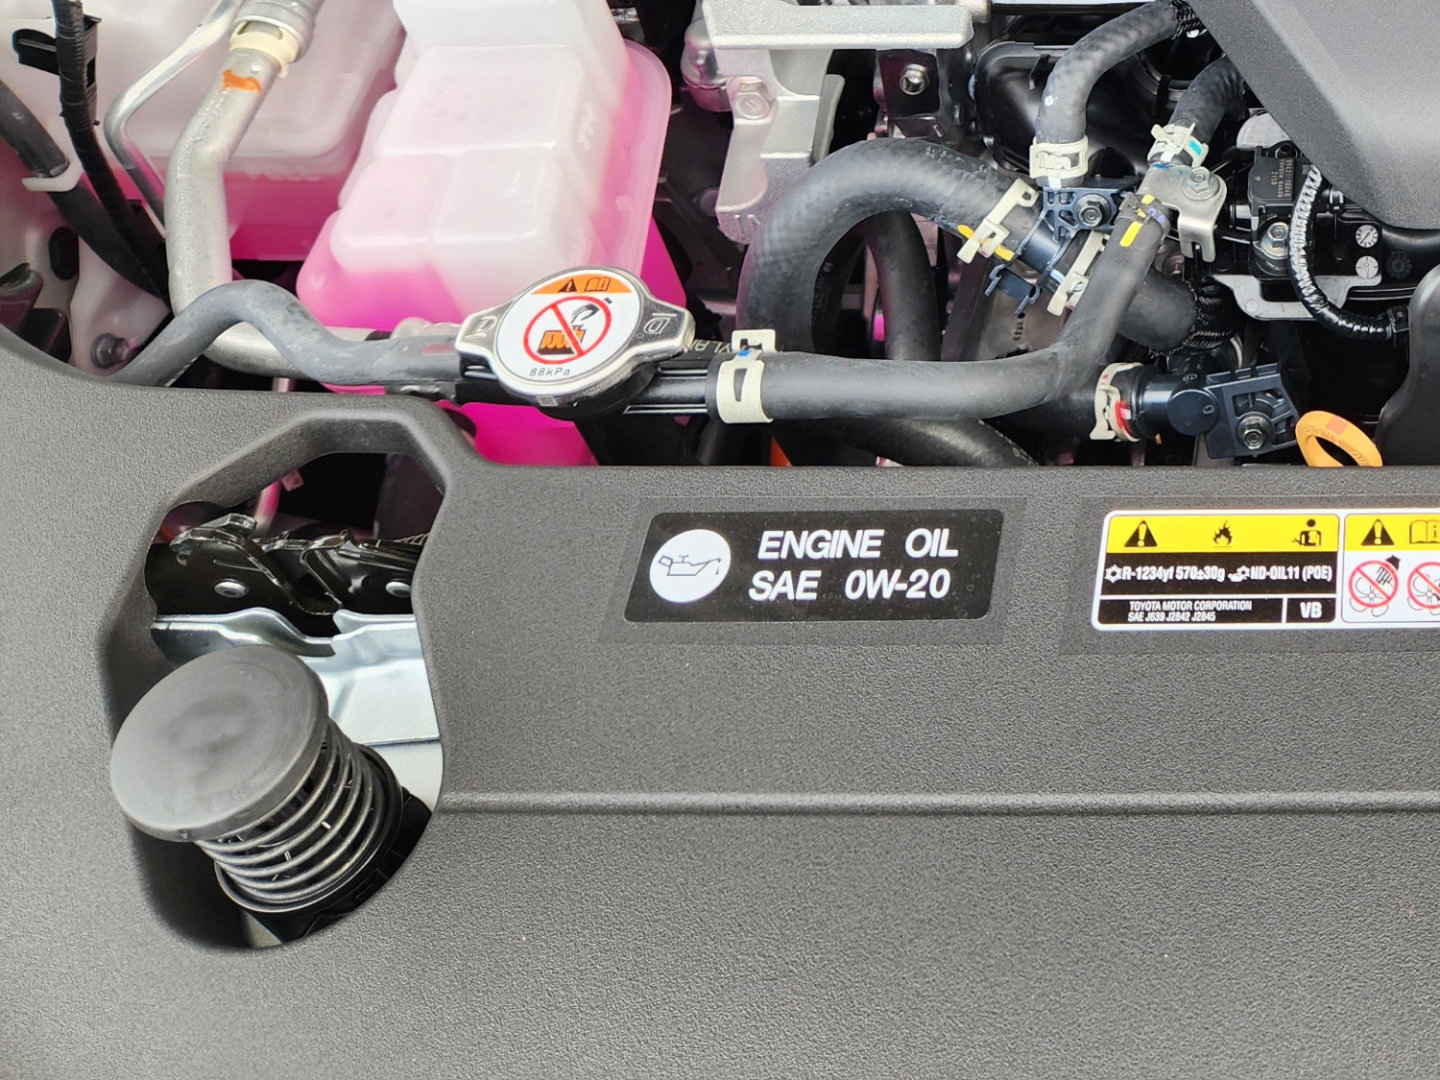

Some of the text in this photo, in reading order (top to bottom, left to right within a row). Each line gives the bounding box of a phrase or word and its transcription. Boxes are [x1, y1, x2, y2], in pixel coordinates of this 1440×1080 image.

[529, 366, 571, 377] 88kPa
[757, 528, 959, 560] ENGINE OIL
[1122, 566, 1174, 582] R-1234yf
[1250, 565, 1300, 580] ND-OIL11
[1302, 565, 1332, 581] (POE)
[749, 568, 951, 601] SAE 0W-20
[1128, 611, 1216, 622] SAE J639 J2842 J2845
[1130, 601, 1322, 618] TOYOTA MOTOR CORPORATION VB
